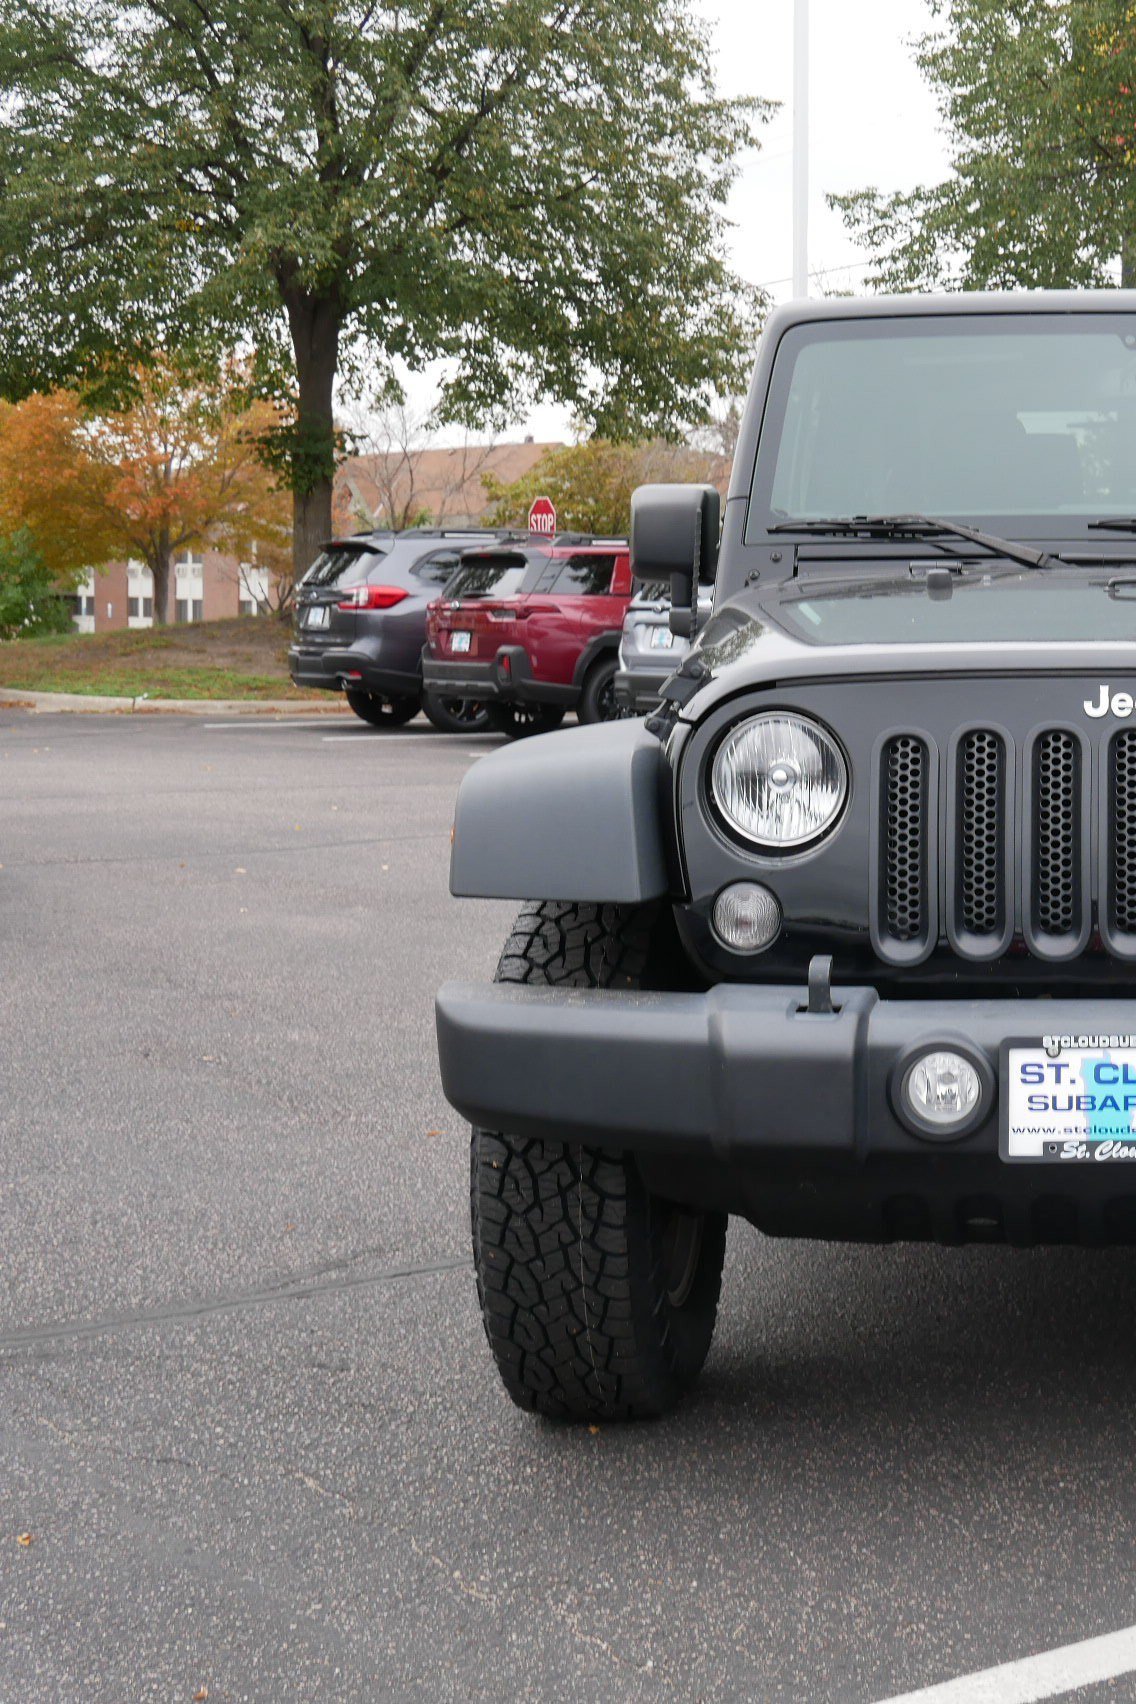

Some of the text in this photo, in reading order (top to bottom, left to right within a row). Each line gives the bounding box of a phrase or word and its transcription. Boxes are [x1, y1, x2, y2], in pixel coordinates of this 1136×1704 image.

[530, 513, 554, 533] STOP
[1020, 1062, 1076, 1085] ST.
[1059, 1140, 1091, 1160] St.
